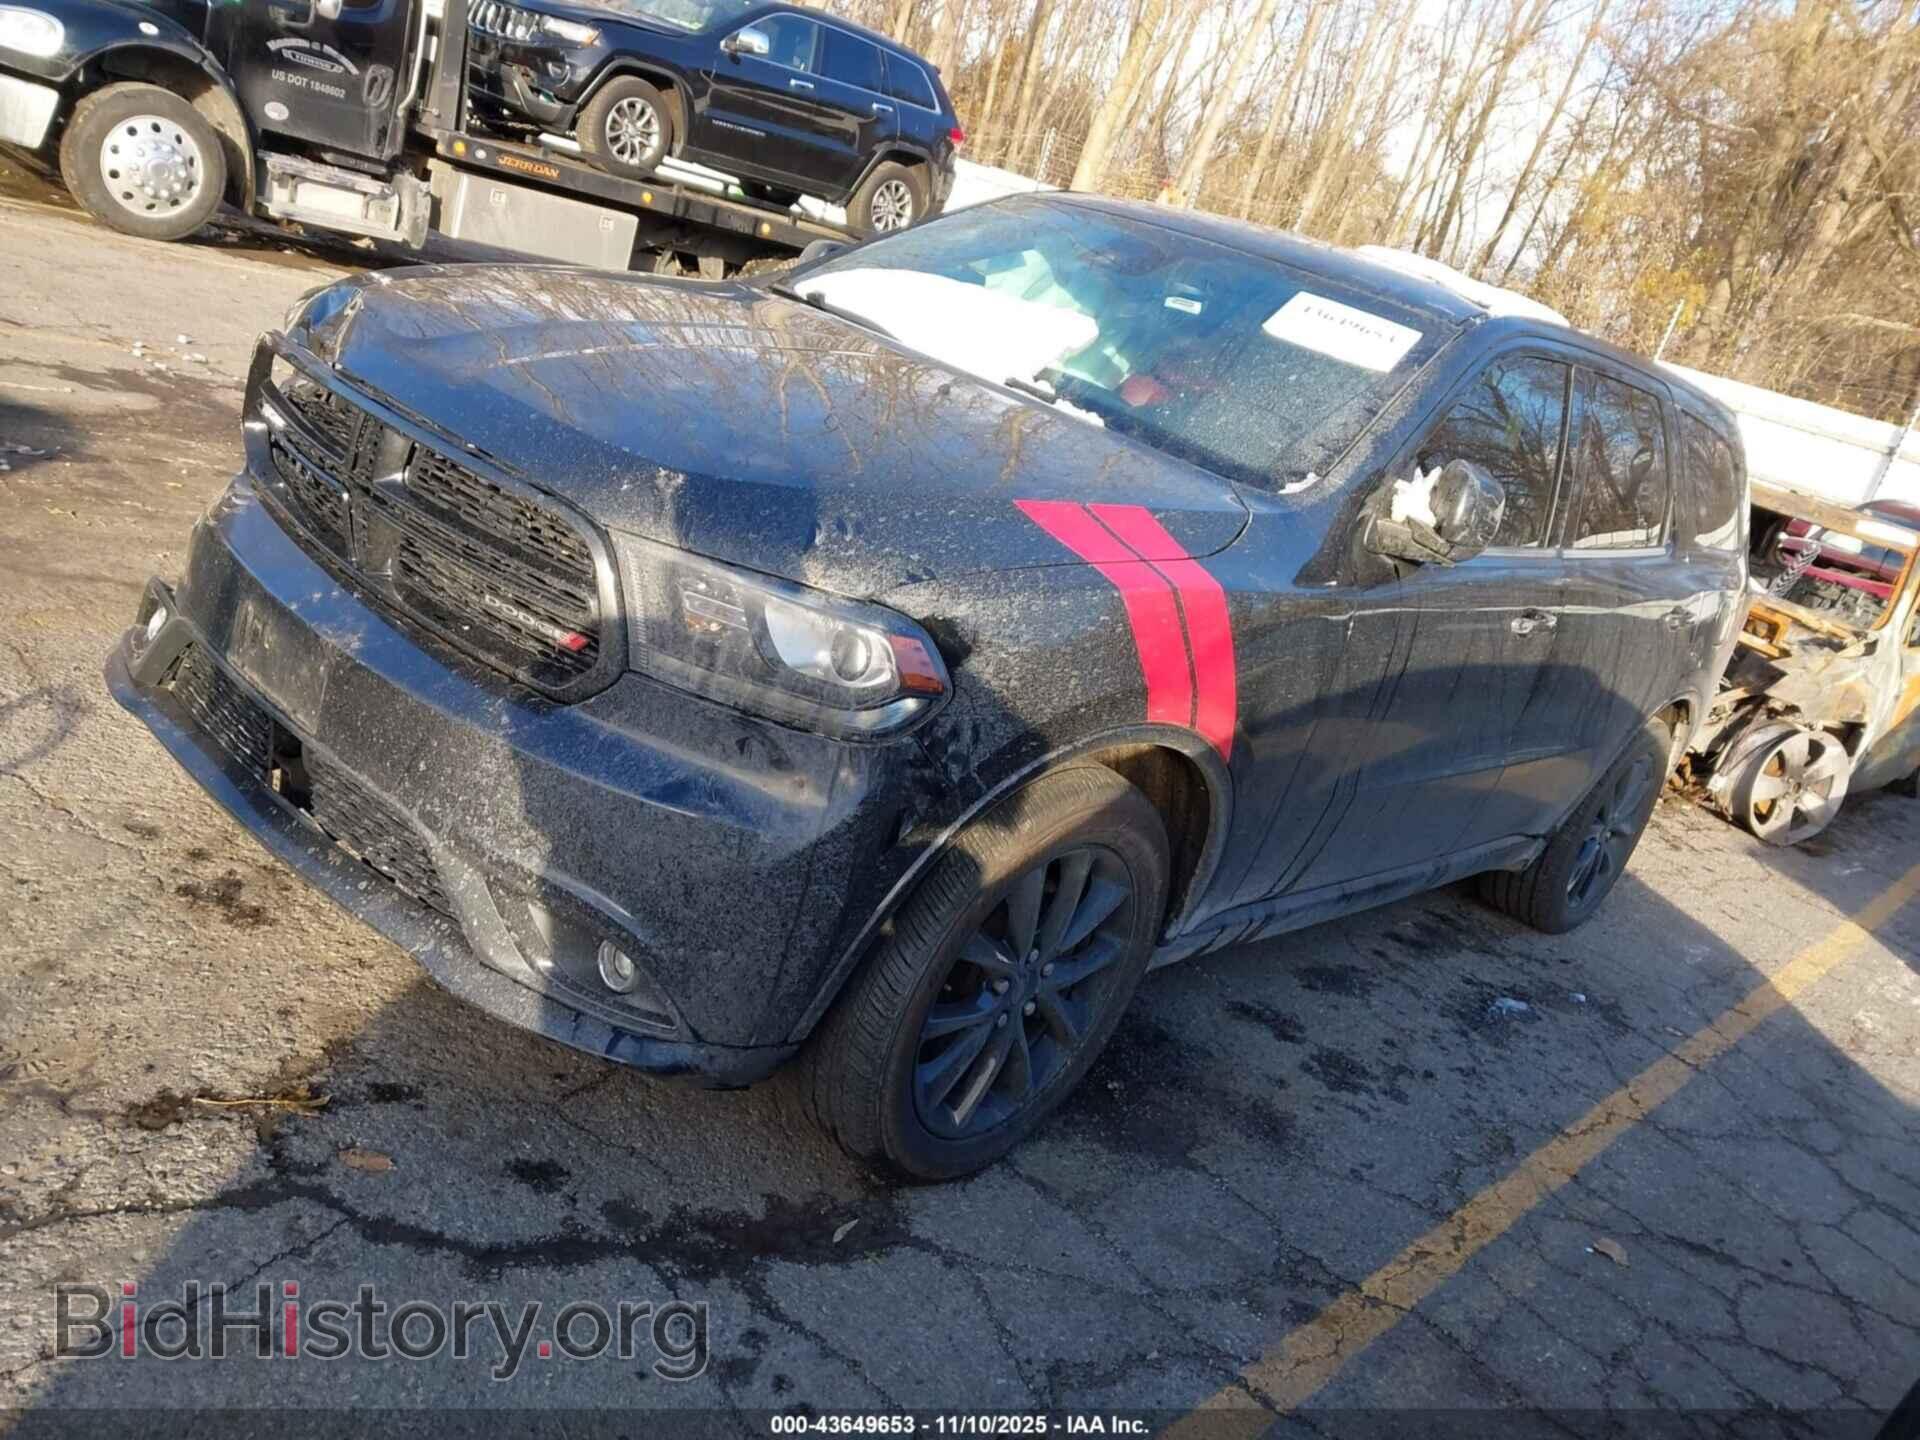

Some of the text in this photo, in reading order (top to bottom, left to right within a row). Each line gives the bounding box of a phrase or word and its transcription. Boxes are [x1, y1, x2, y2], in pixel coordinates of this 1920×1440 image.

[271, 69, 286, 81] US
[287, 73, 309, 88] DOT
[485, 594, 568, 643] DODGE
